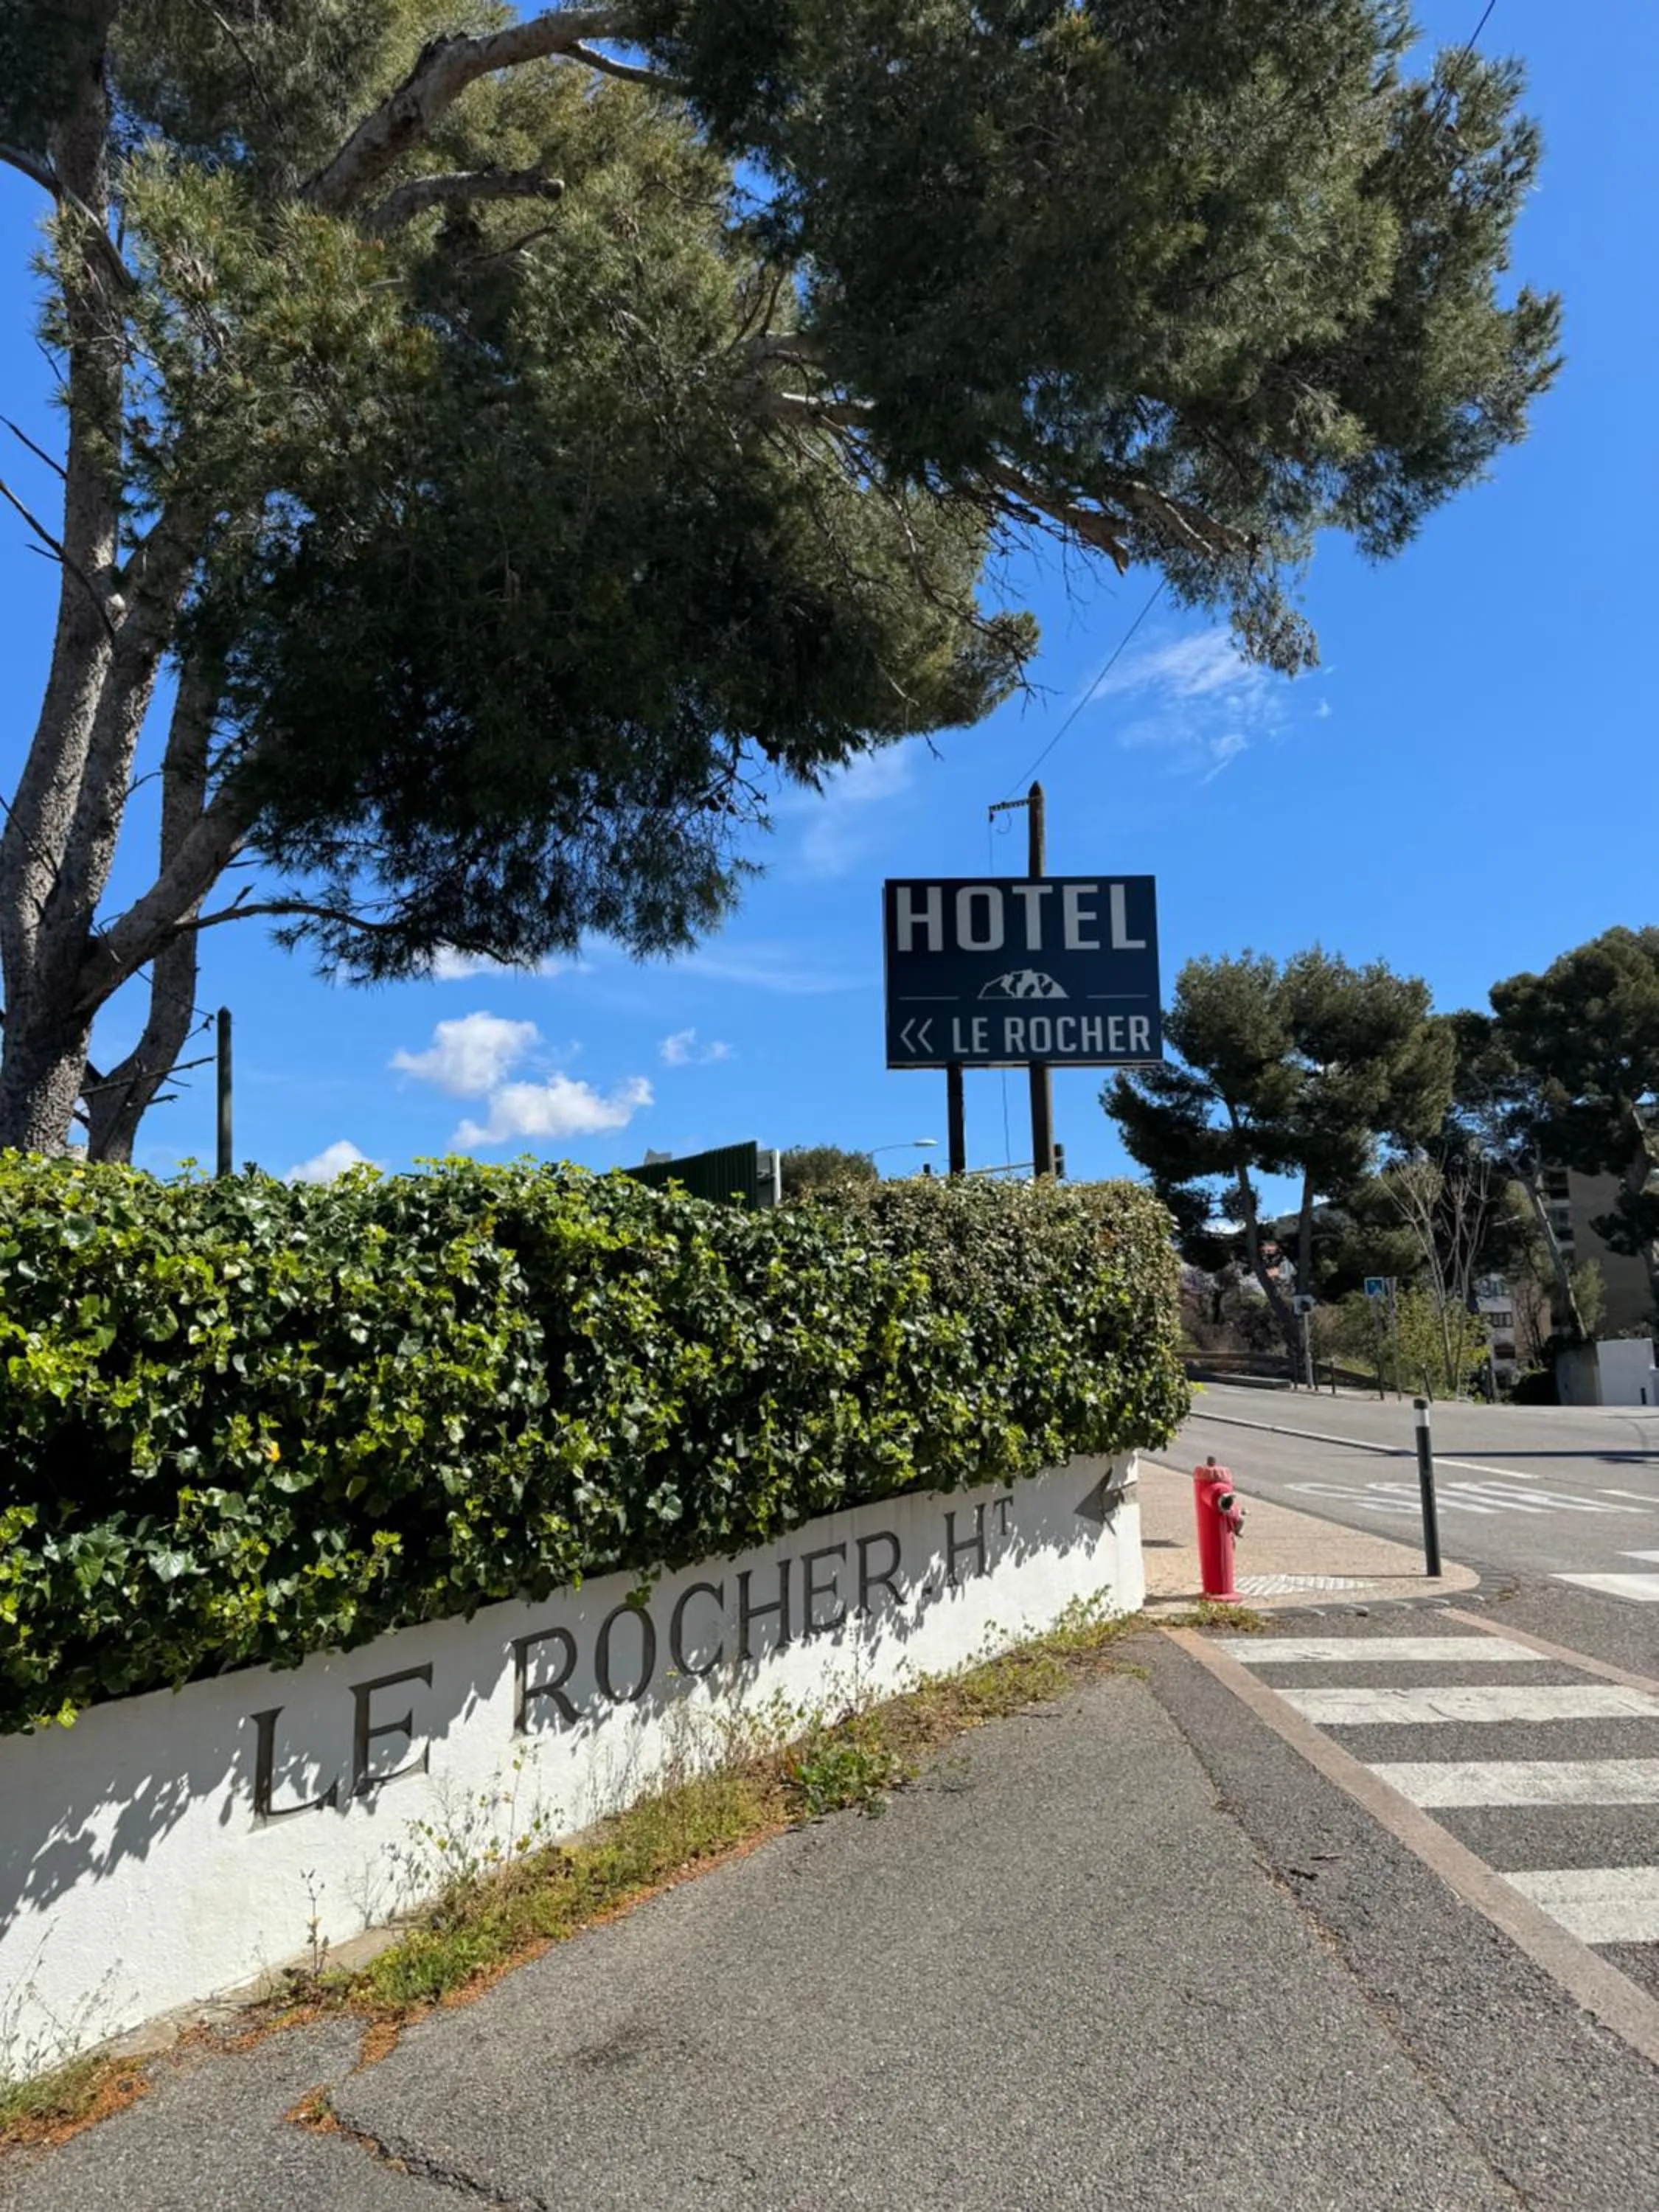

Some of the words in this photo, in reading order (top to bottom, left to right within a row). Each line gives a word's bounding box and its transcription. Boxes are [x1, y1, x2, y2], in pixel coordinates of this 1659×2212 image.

[896, 885, 1147, 952] HOTEL
[953, 1017, 990, 1053] LE
[1004, 1015, 1151, 1053] ROCHER
[247, 1661, 434, 1833] LE
